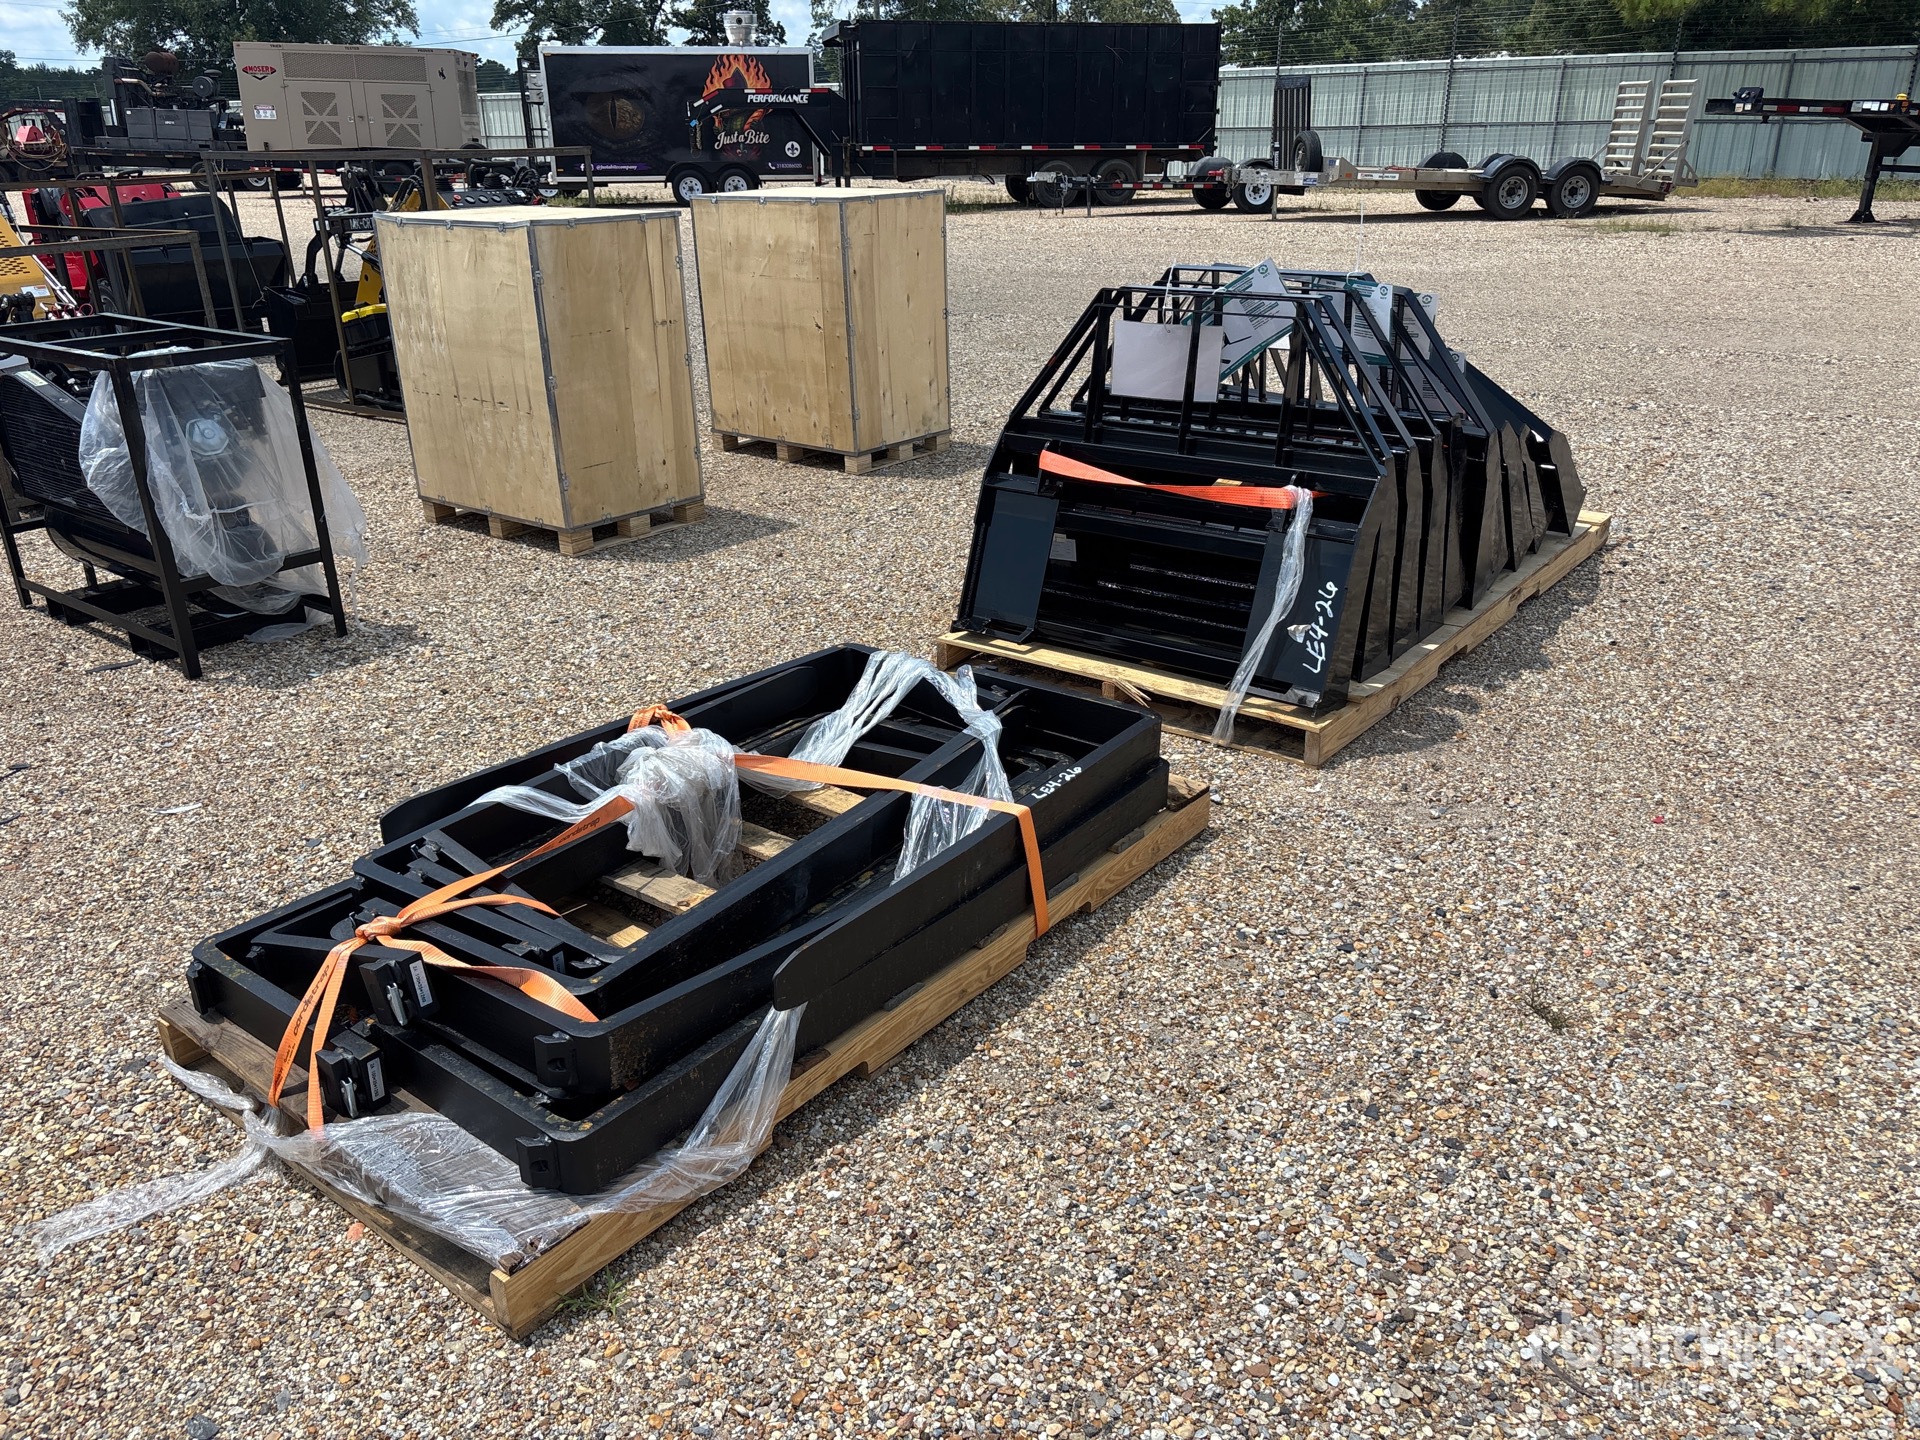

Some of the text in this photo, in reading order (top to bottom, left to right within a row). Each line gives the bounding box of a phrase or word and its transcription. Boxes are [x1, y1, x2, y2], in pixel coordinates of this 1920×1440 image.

[248, 65, 271, 73] MOSER
[747, 93, 810, 104] PERFORMANCE
[714, 129, 770, 150] Just a Bite
[350, 217, 374, 230] MK-CR
[1302, 581, 1338, 673] LE4-26
[1031, 766, 1082, 799] LE4-26
[293, 965, 330, 1037] cordstrap
